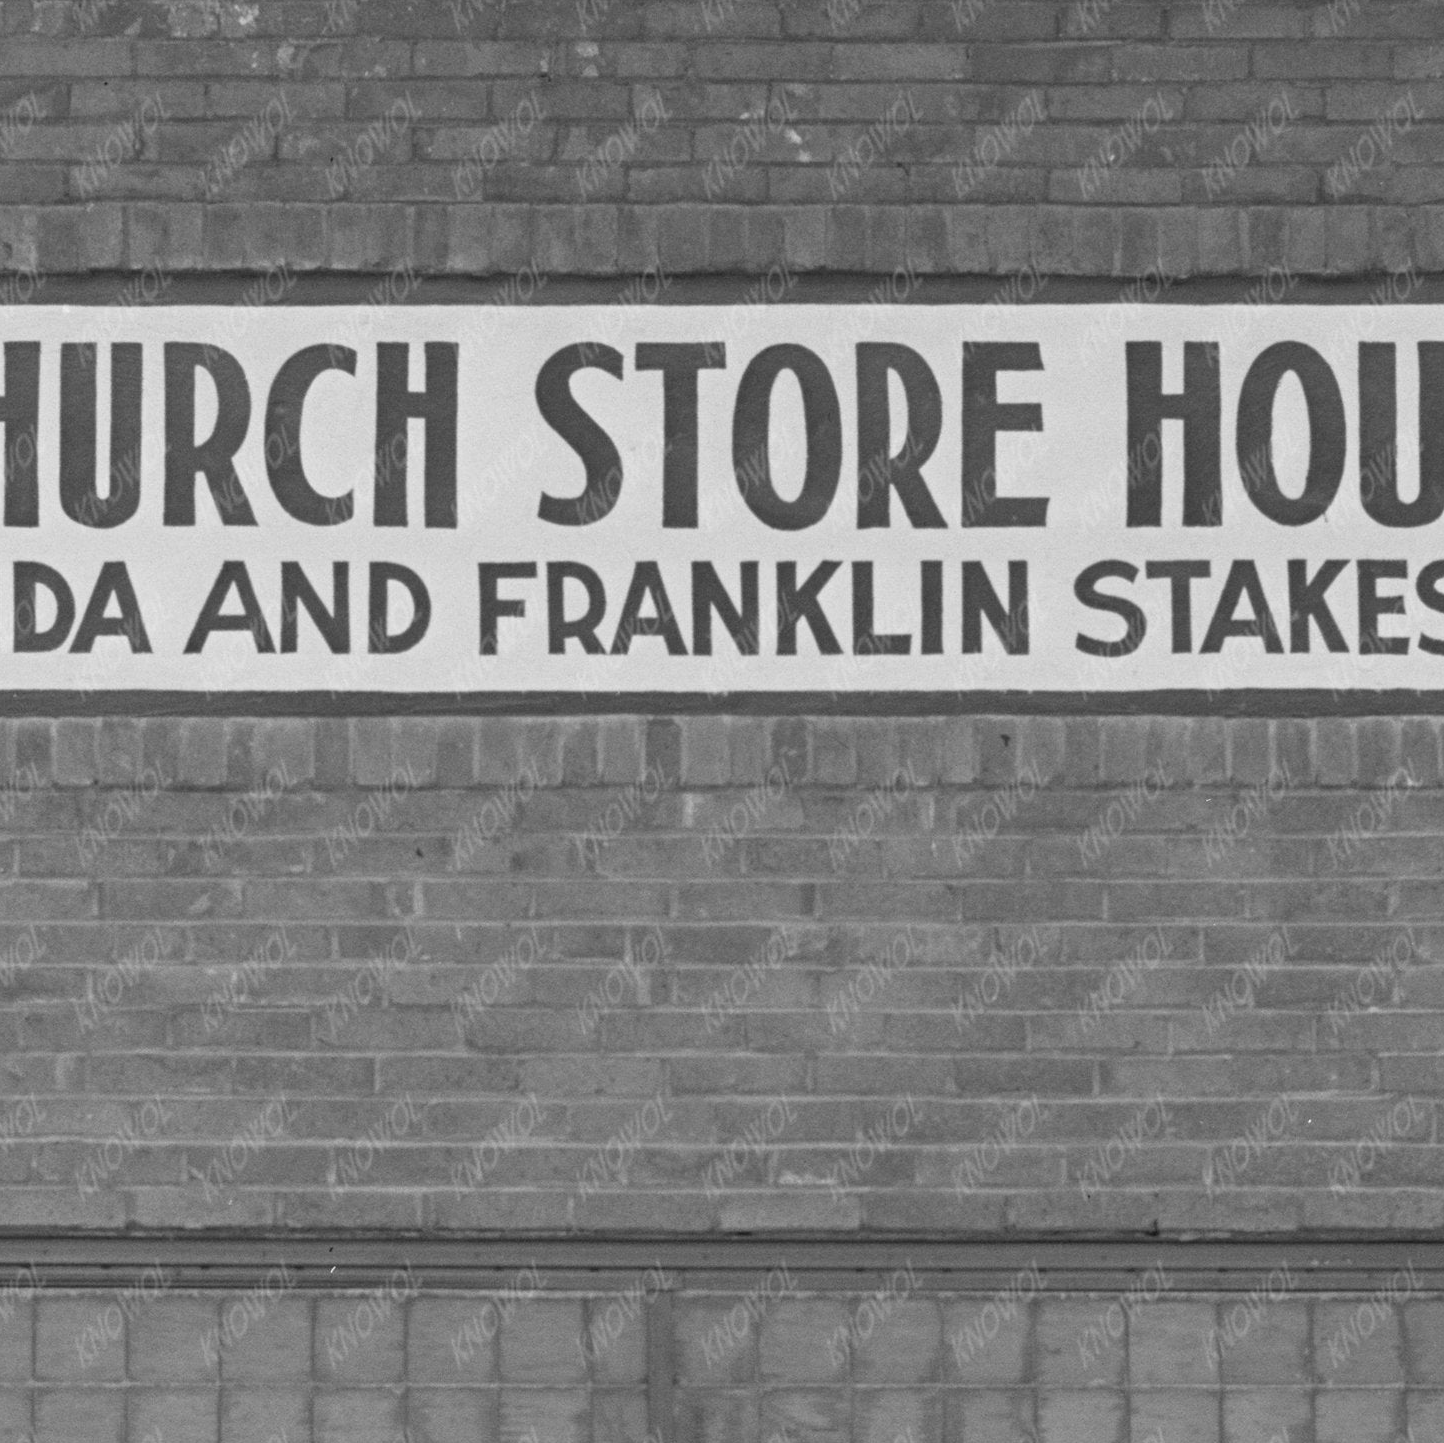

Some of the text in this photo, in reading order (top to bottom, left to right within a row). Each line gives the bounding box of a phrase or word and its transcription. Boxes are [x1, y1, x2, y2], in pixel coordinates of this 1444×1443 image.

[534, 340, 1050, 531] STORE
[183, 558, 433, 655] AND
[476, 559, 1030, 656] FRANKLIN
